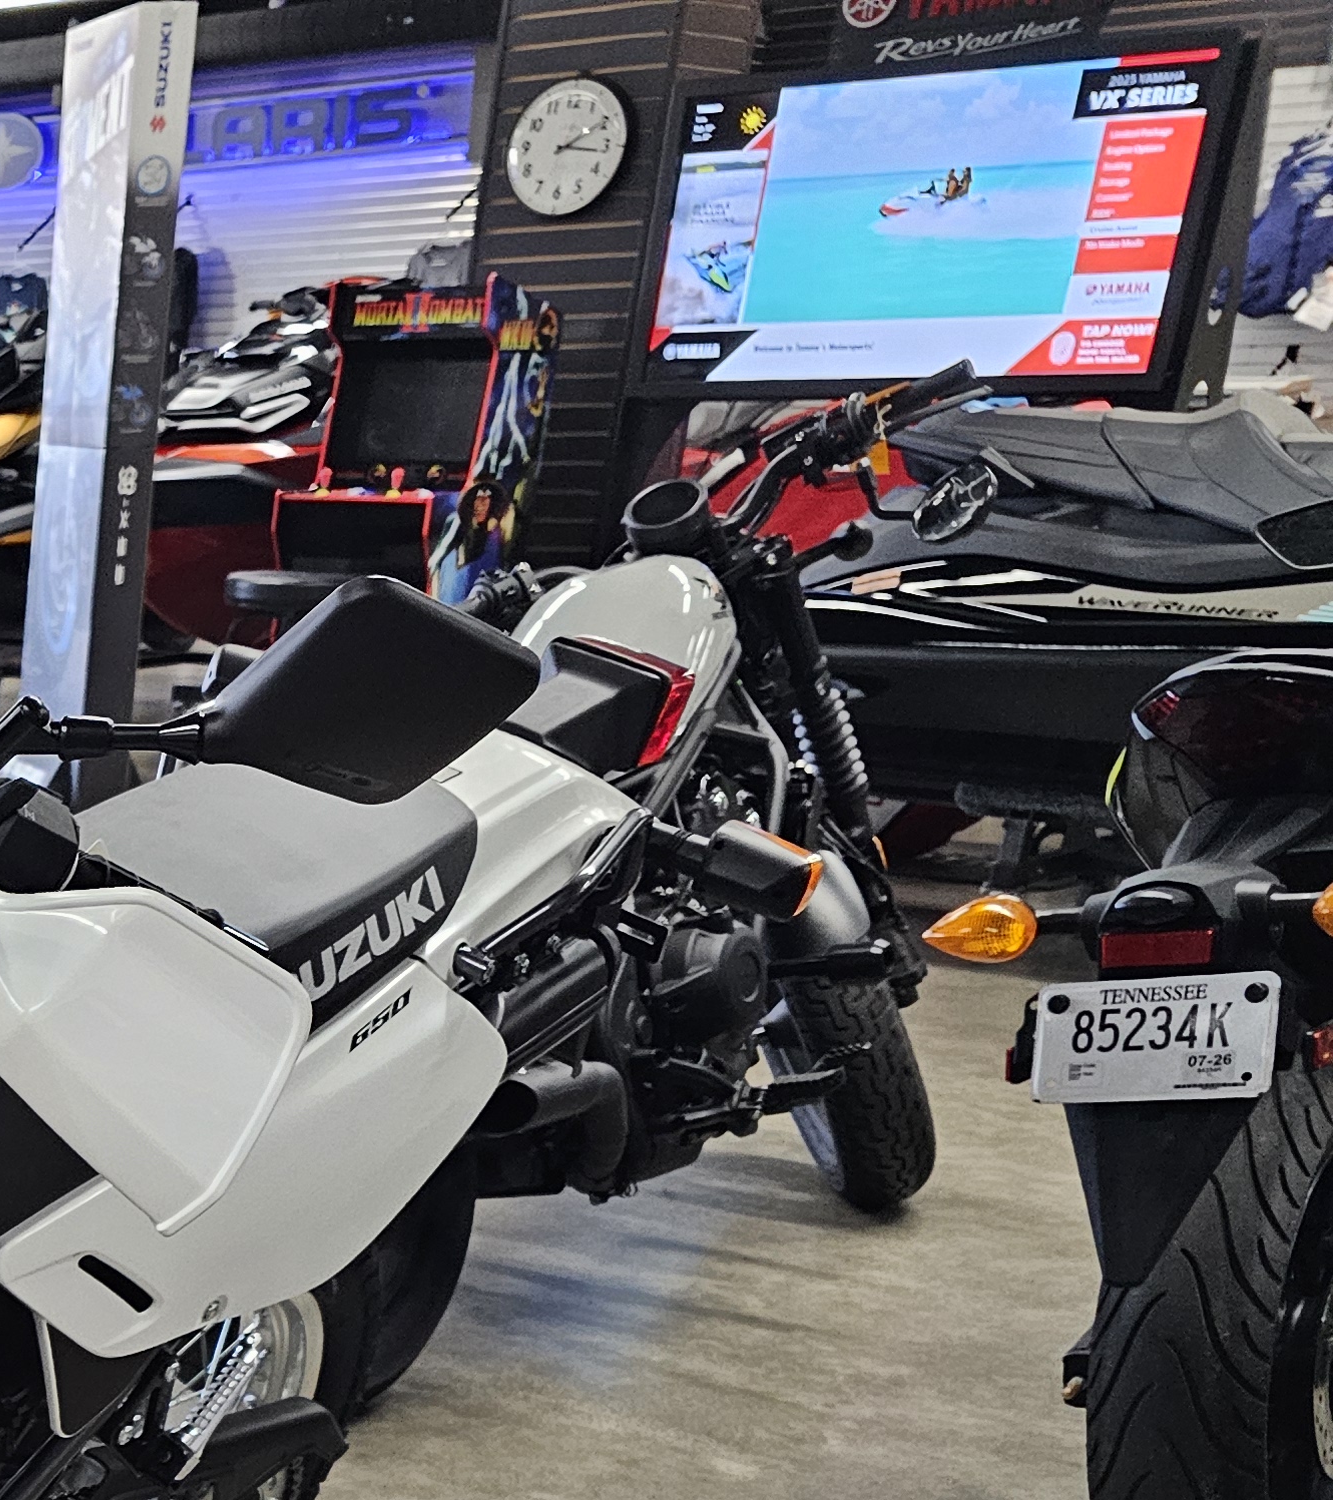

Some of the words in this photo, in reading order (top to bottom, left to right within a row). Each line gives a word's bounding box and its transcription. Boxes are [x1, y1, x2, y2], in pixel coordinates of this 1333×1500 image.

[874, 36, 952, 64] Revs
[953, 30, 1015, 56] Your
[1012, 17, 1081, 42] Heart
[153, 21, 172, 109] SUZUKI
[1138, 70, 1186, 86] YAMAHA
[566, 94, 582, 109] 12
[1126, 83, 1200, 108] SERIES
[546, 100, 560, 115] 11
[589, 101, 597, 114] 1
[521, 141, 532, 155] 9
[590, 161, 601, 176] 4
[535, 179, 544, 195] 7
[552, 185, 562, 200] 6
[573, 178, 583, 194] 5
[1100, 282, 1150, 296] YAMAHA
[298, 865, 446, 1002] UZUKI
[1100, 983, 1208, 1005] TENNESSEE
[348, 985, 413, 1054] 650
[1071, 1001, 1234, 1054] 85234K
[1187, 1053, 1233, 1068] 07-26
